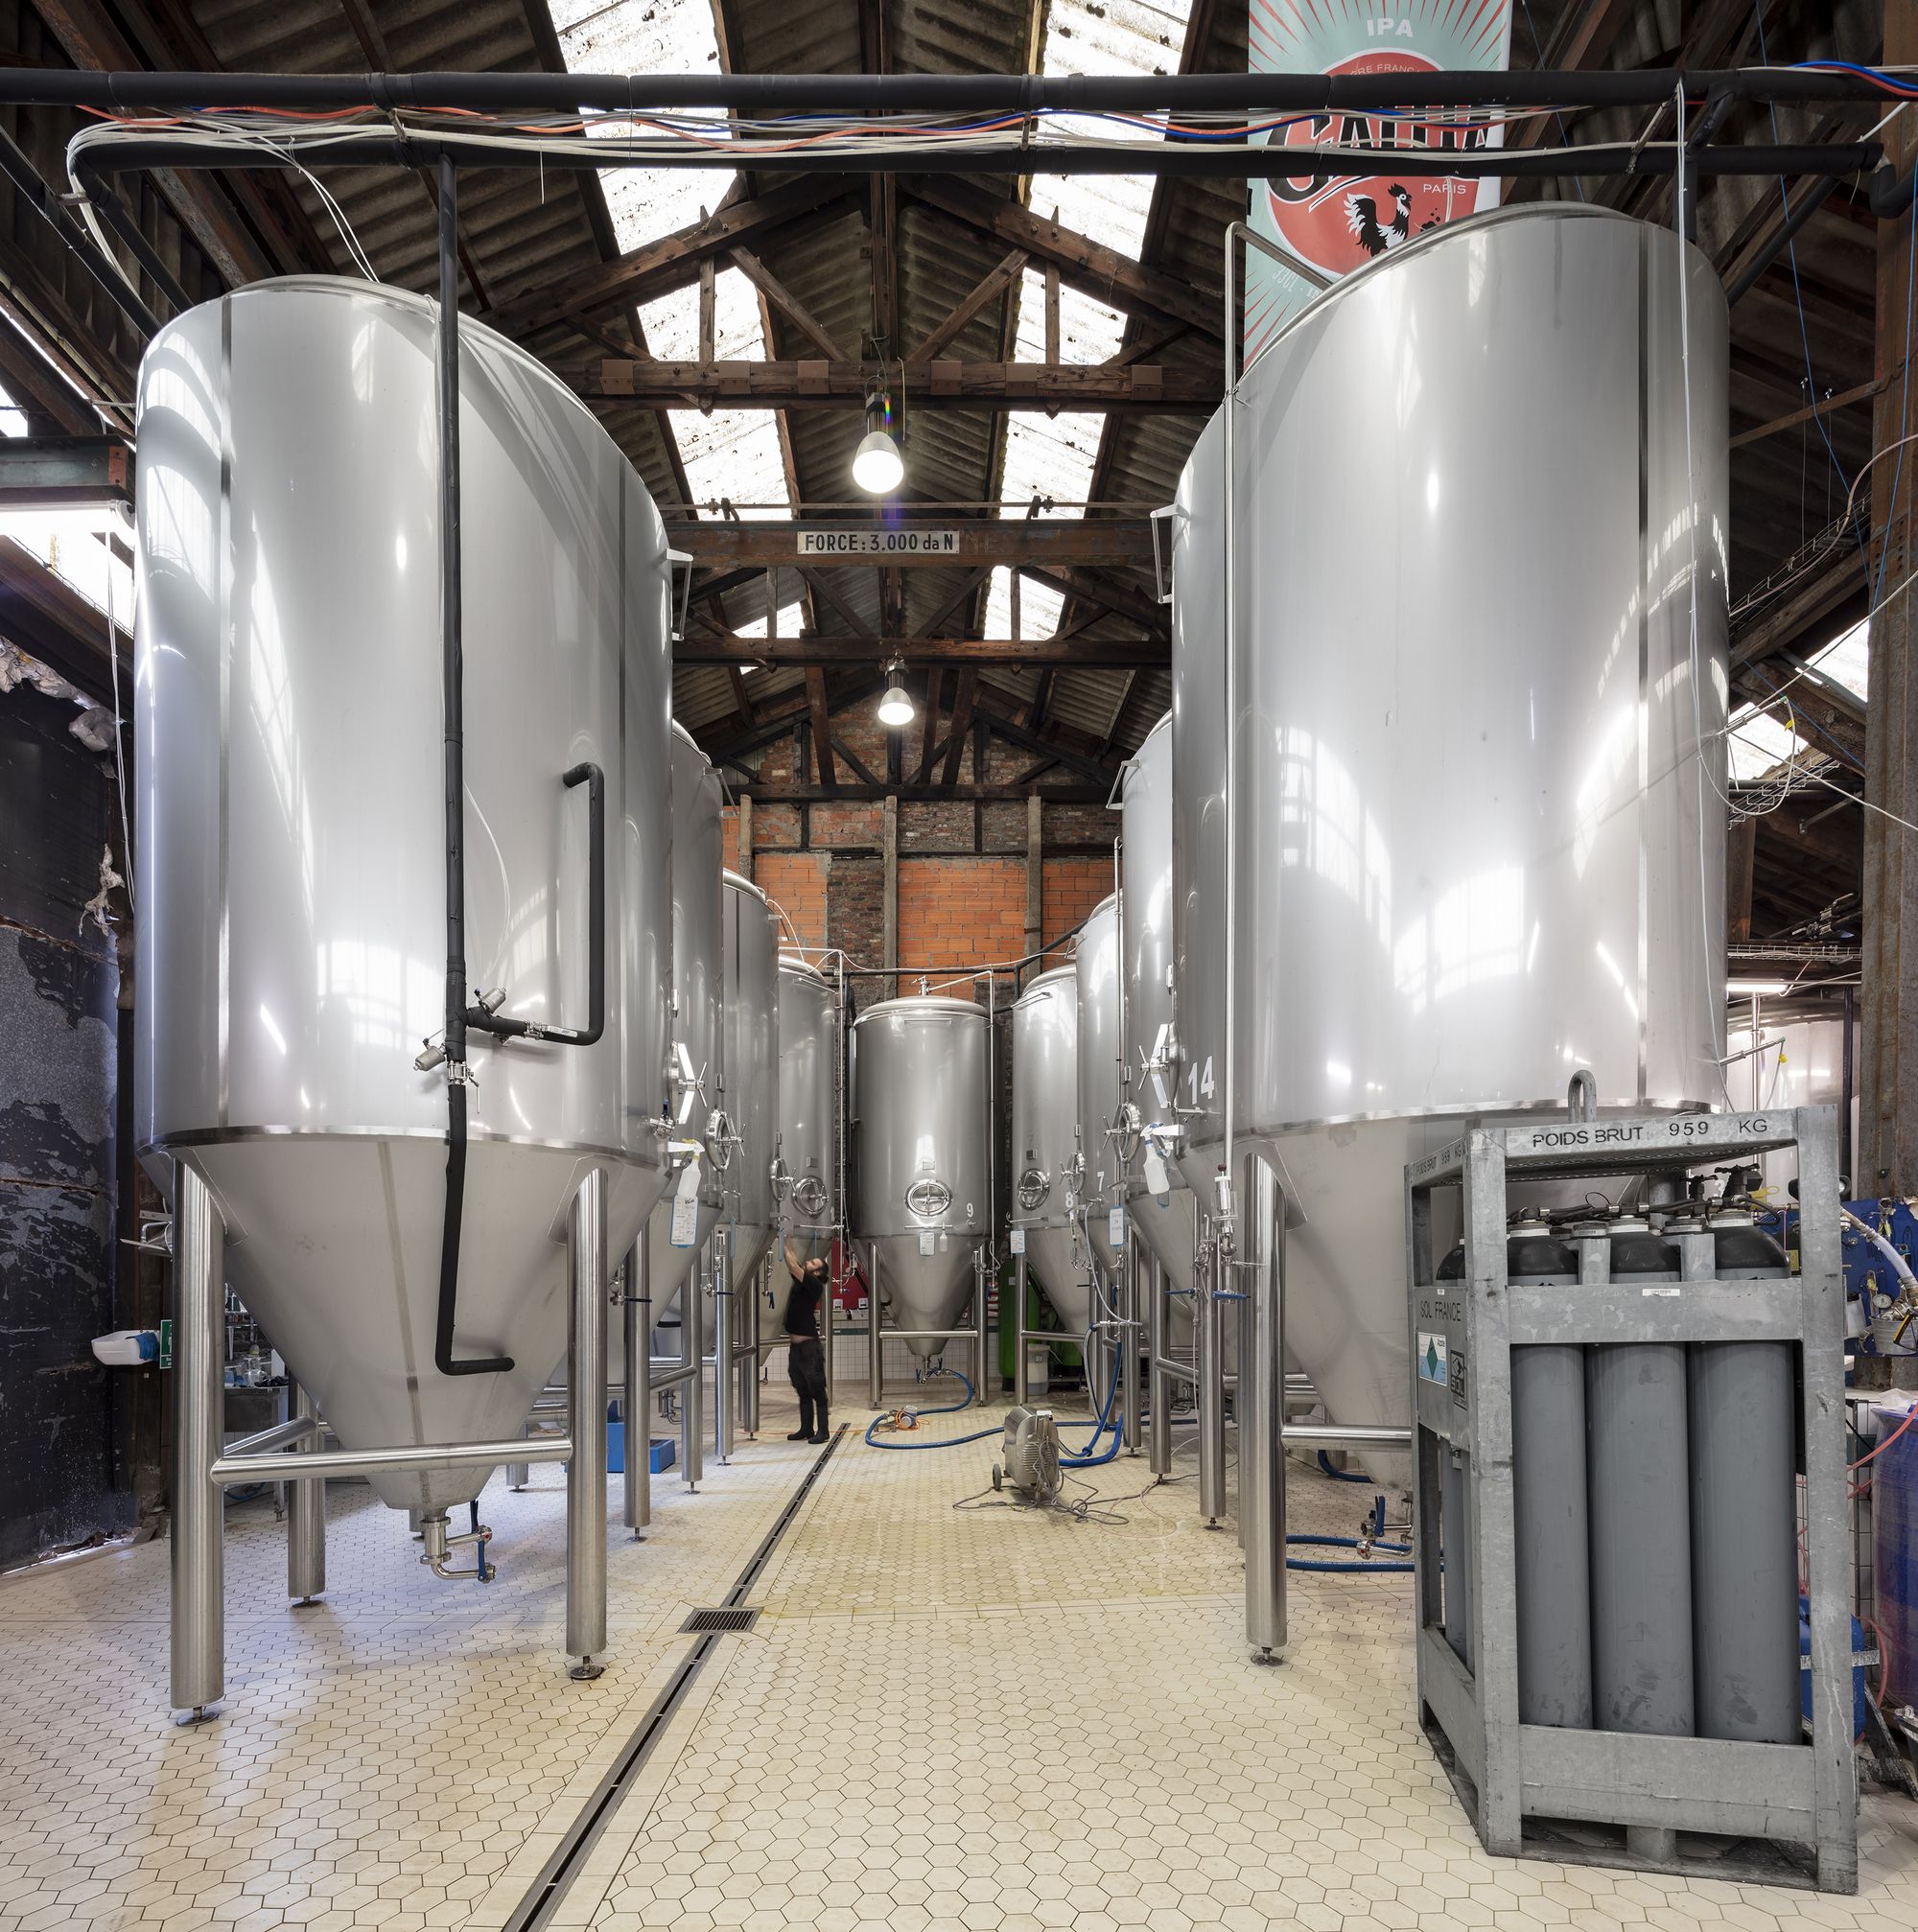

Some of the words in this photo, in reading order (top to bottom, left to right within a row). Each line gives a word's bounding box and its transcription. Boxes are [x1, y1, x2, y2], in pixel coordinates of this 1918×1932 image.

[1367, 17, 1414, 38] IPA
[1422, 183, 1466, 195] PARIS
[1187, 1056, 1215, 1106] 14
[1532, 1130, 1589, 1148] POIDS
[1595, 1127, 1643, 1144] BRUT
[1669, 1121, 1709, 1136] 959
[1739, 1118, 1767, 1134] KG
[1097, 1171, 1105, 1192] 7
[966, 1202, 974, 1218] 9
[1065, 1191, 1074, 1208] 8
[1420, 1300, 1433, 1318] SOL
[1435, 1301, 1462, 1322] FRANCE
